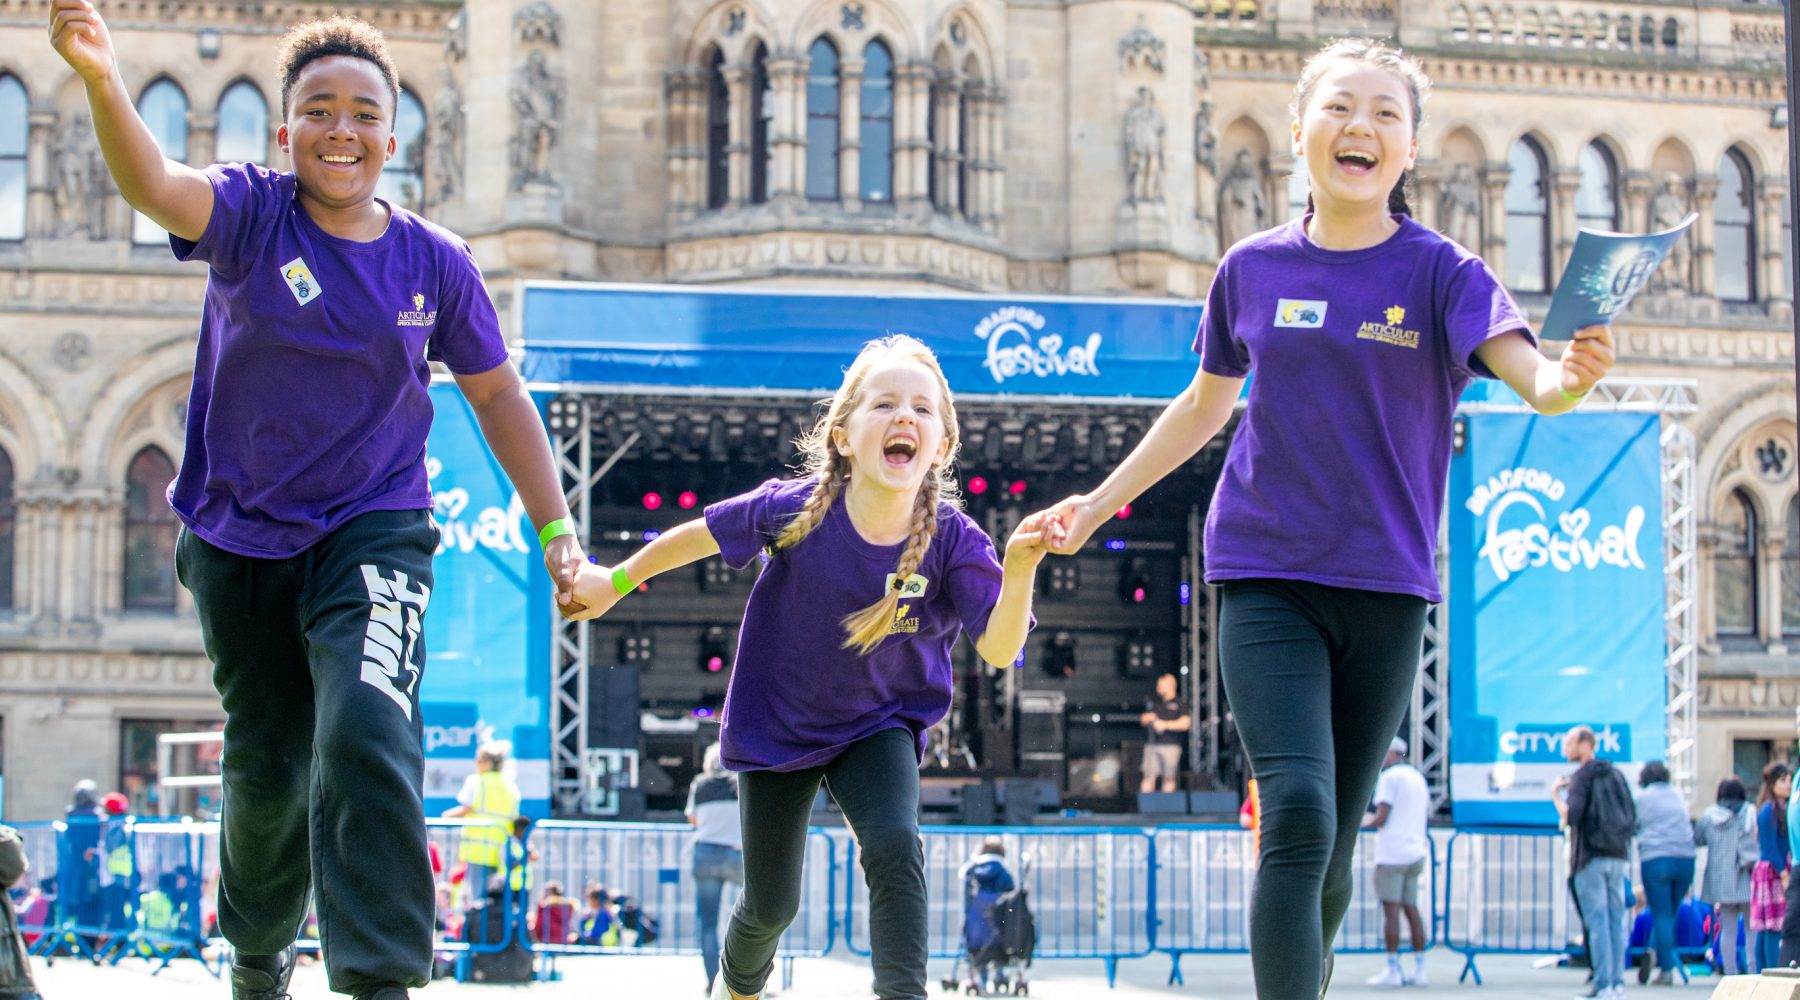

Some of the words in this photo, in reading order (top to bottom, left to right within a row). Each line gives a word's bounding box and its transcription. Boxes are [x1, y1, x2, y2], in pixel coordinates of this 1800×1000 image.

[974, 306, 1046, 339] BRADFORD
[1358, 320, 1420, 341] ARTICULATE
[1465, 467, 1565, 516] BRADFORD
[434, 487, 531, 555] ival
[360, 564, 430, 722] NIKE
[423, 719, 496, 752] park
